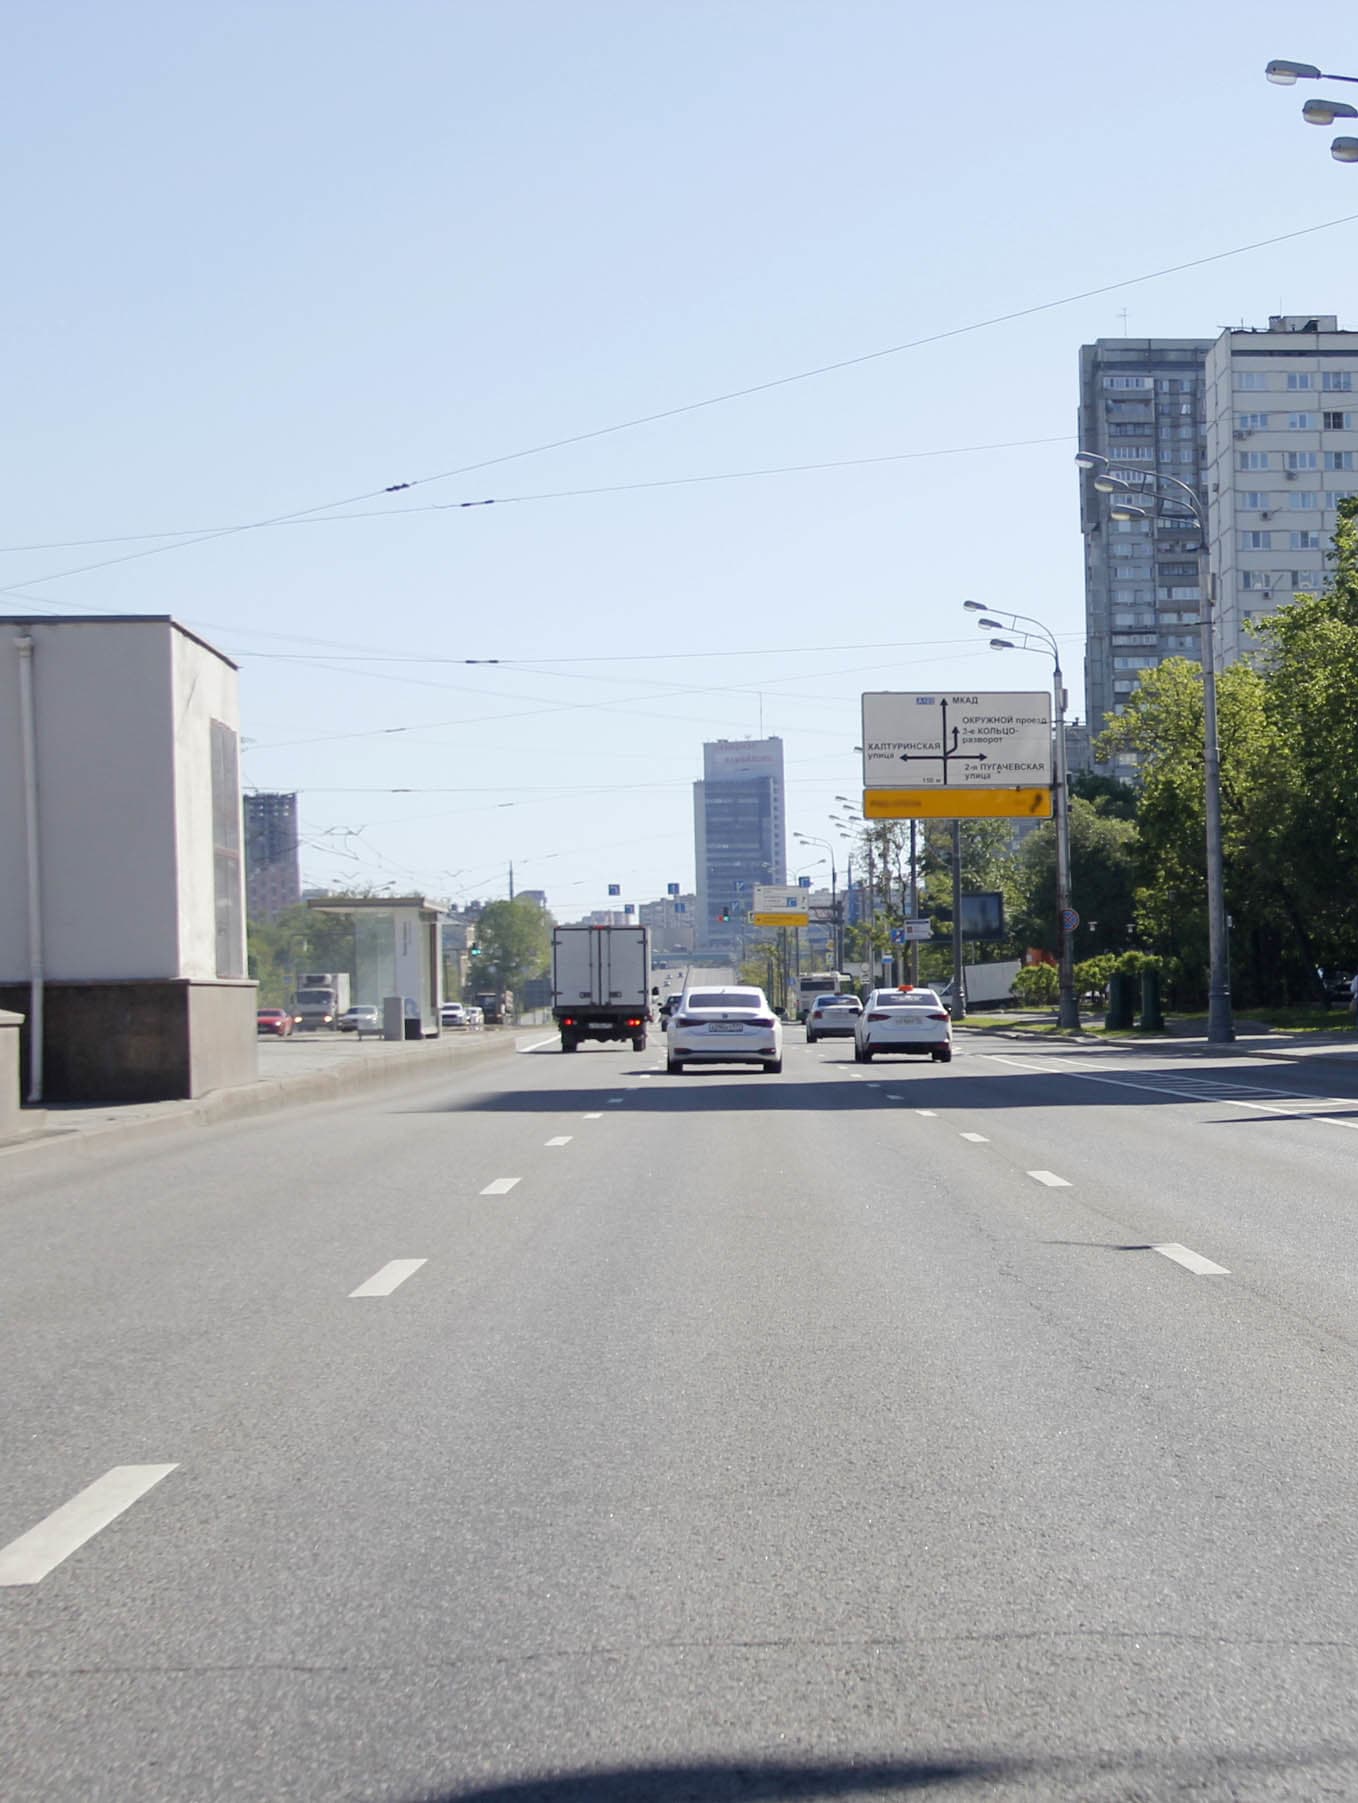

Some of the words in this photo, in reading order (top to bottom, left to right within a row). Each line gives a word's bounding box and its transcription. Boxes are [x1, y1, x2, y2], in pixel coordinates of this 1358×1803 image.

[952, 697, 978, 705] МКАД
[962, 716, 1013, 724] ОКРУЖНОЙ
[1015, 717, 1047, 727] проезд
[962, 736, 1003, 744] разворот
[867, 742, 941, 750] ХАЛТУРИНСКАЯ
[867, 752, 895, 760] улица
[964, 773, 991, 781] улица
